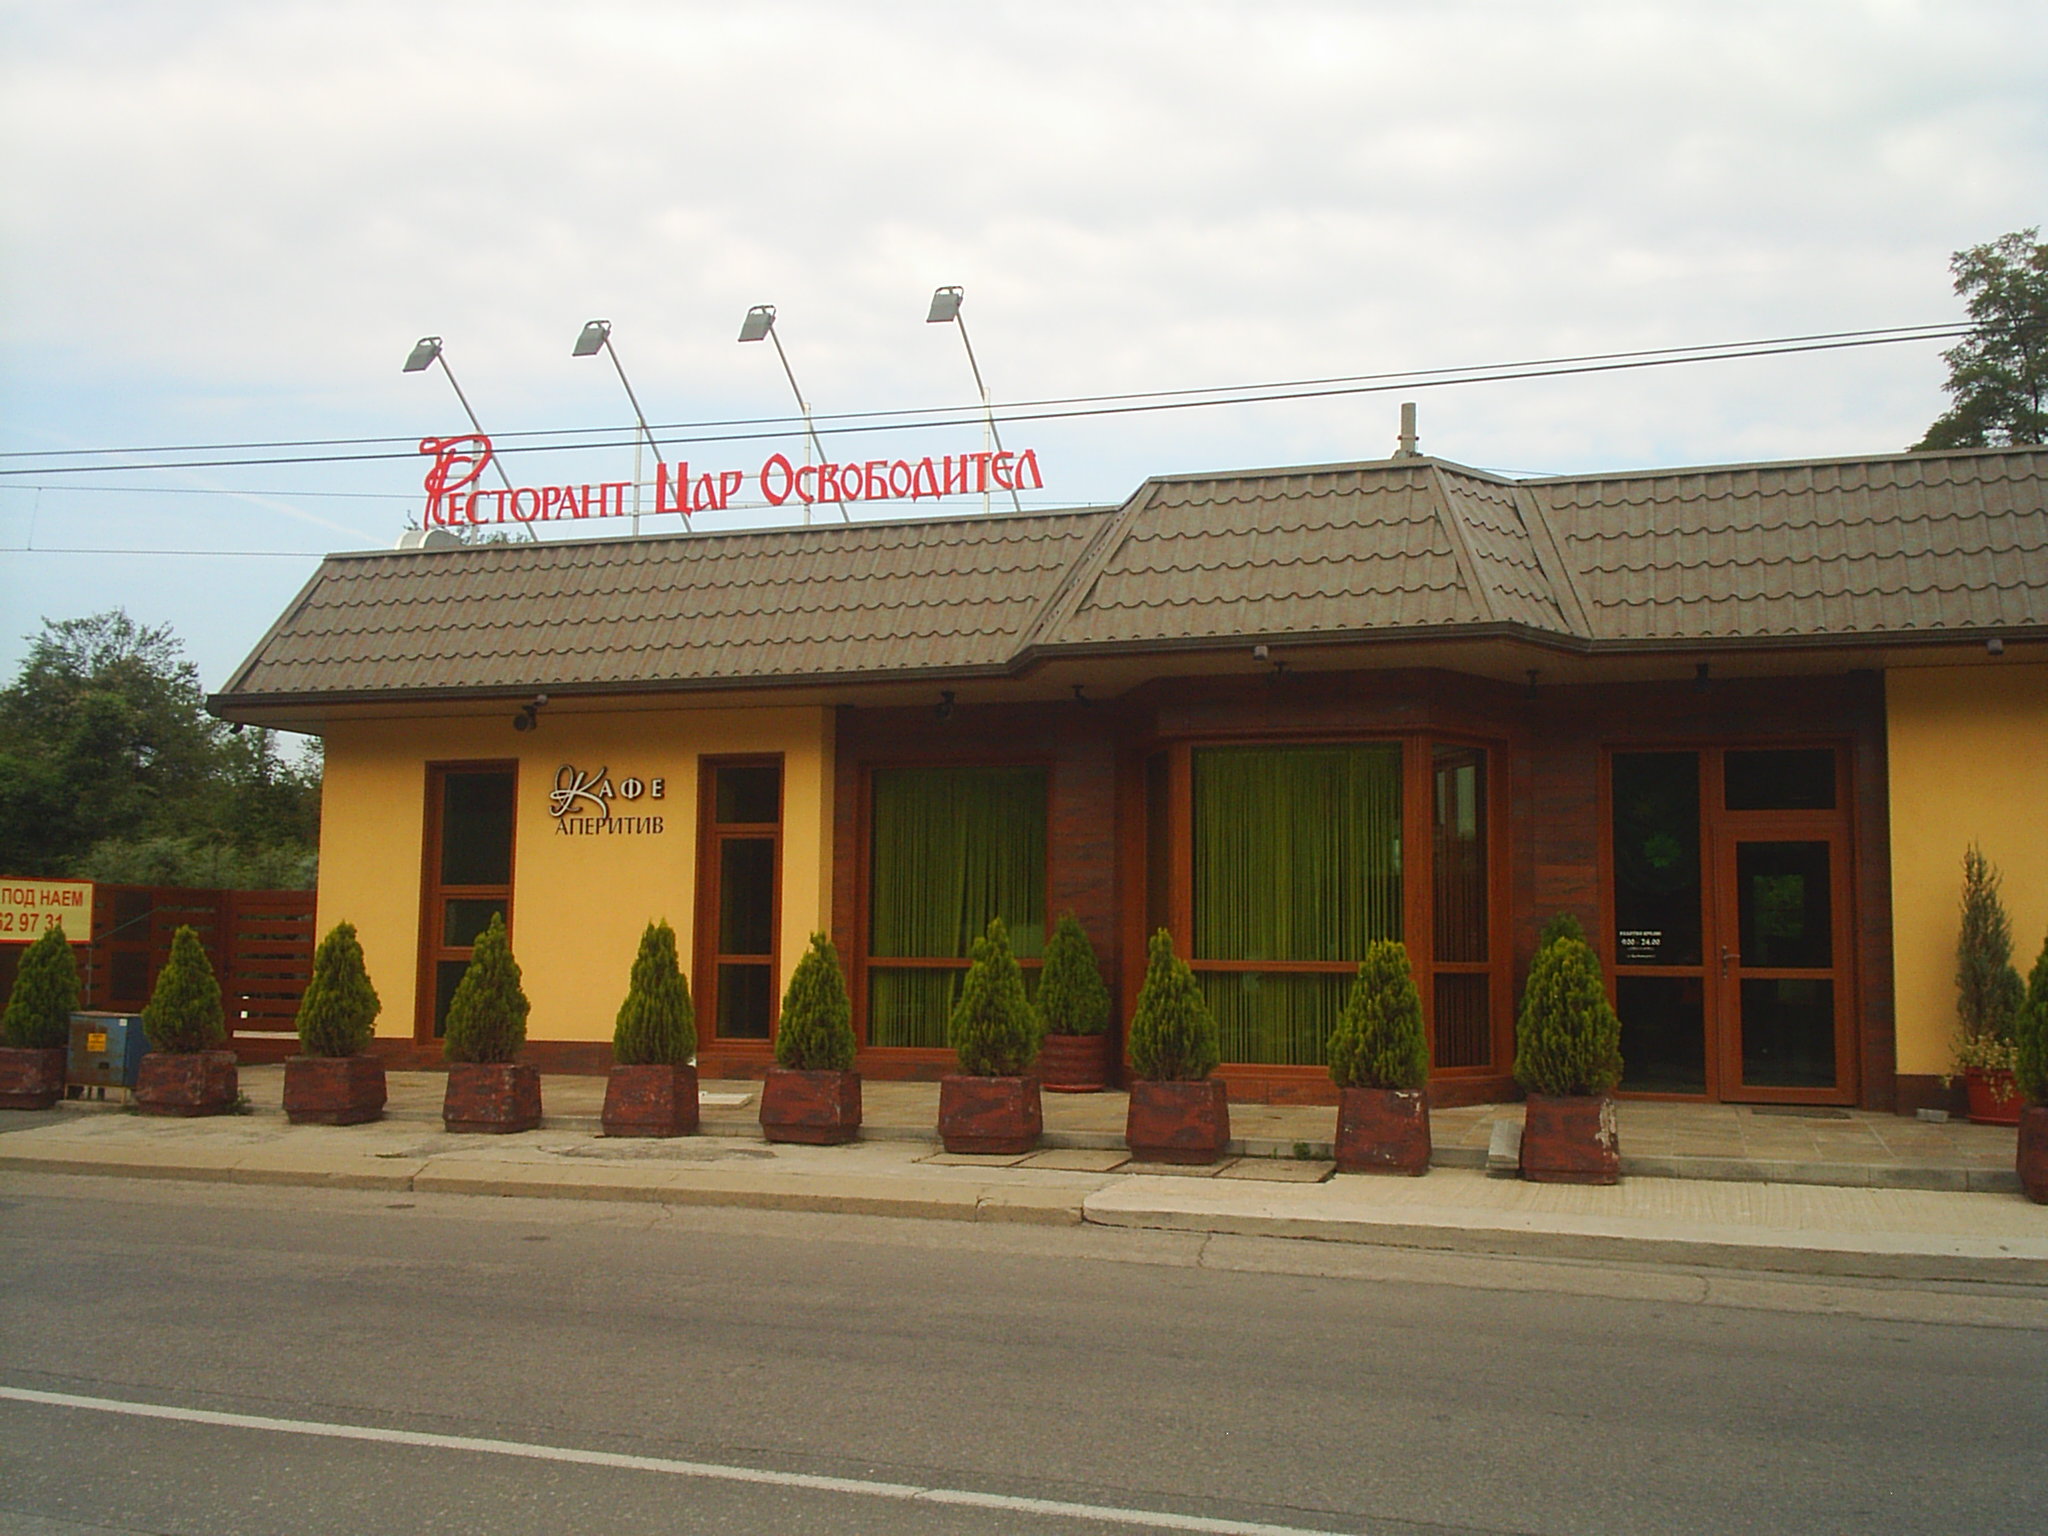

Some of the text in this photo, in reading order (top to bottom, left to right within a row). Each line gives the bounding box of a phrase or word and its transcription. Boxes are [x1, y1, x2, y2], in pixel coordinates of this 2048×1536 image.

[555, 816, 664, 835] АПЕРИТИВ
[2, 888, 83, 908] ПОД НАЕМ
[19, 912, 39, 932] 97
